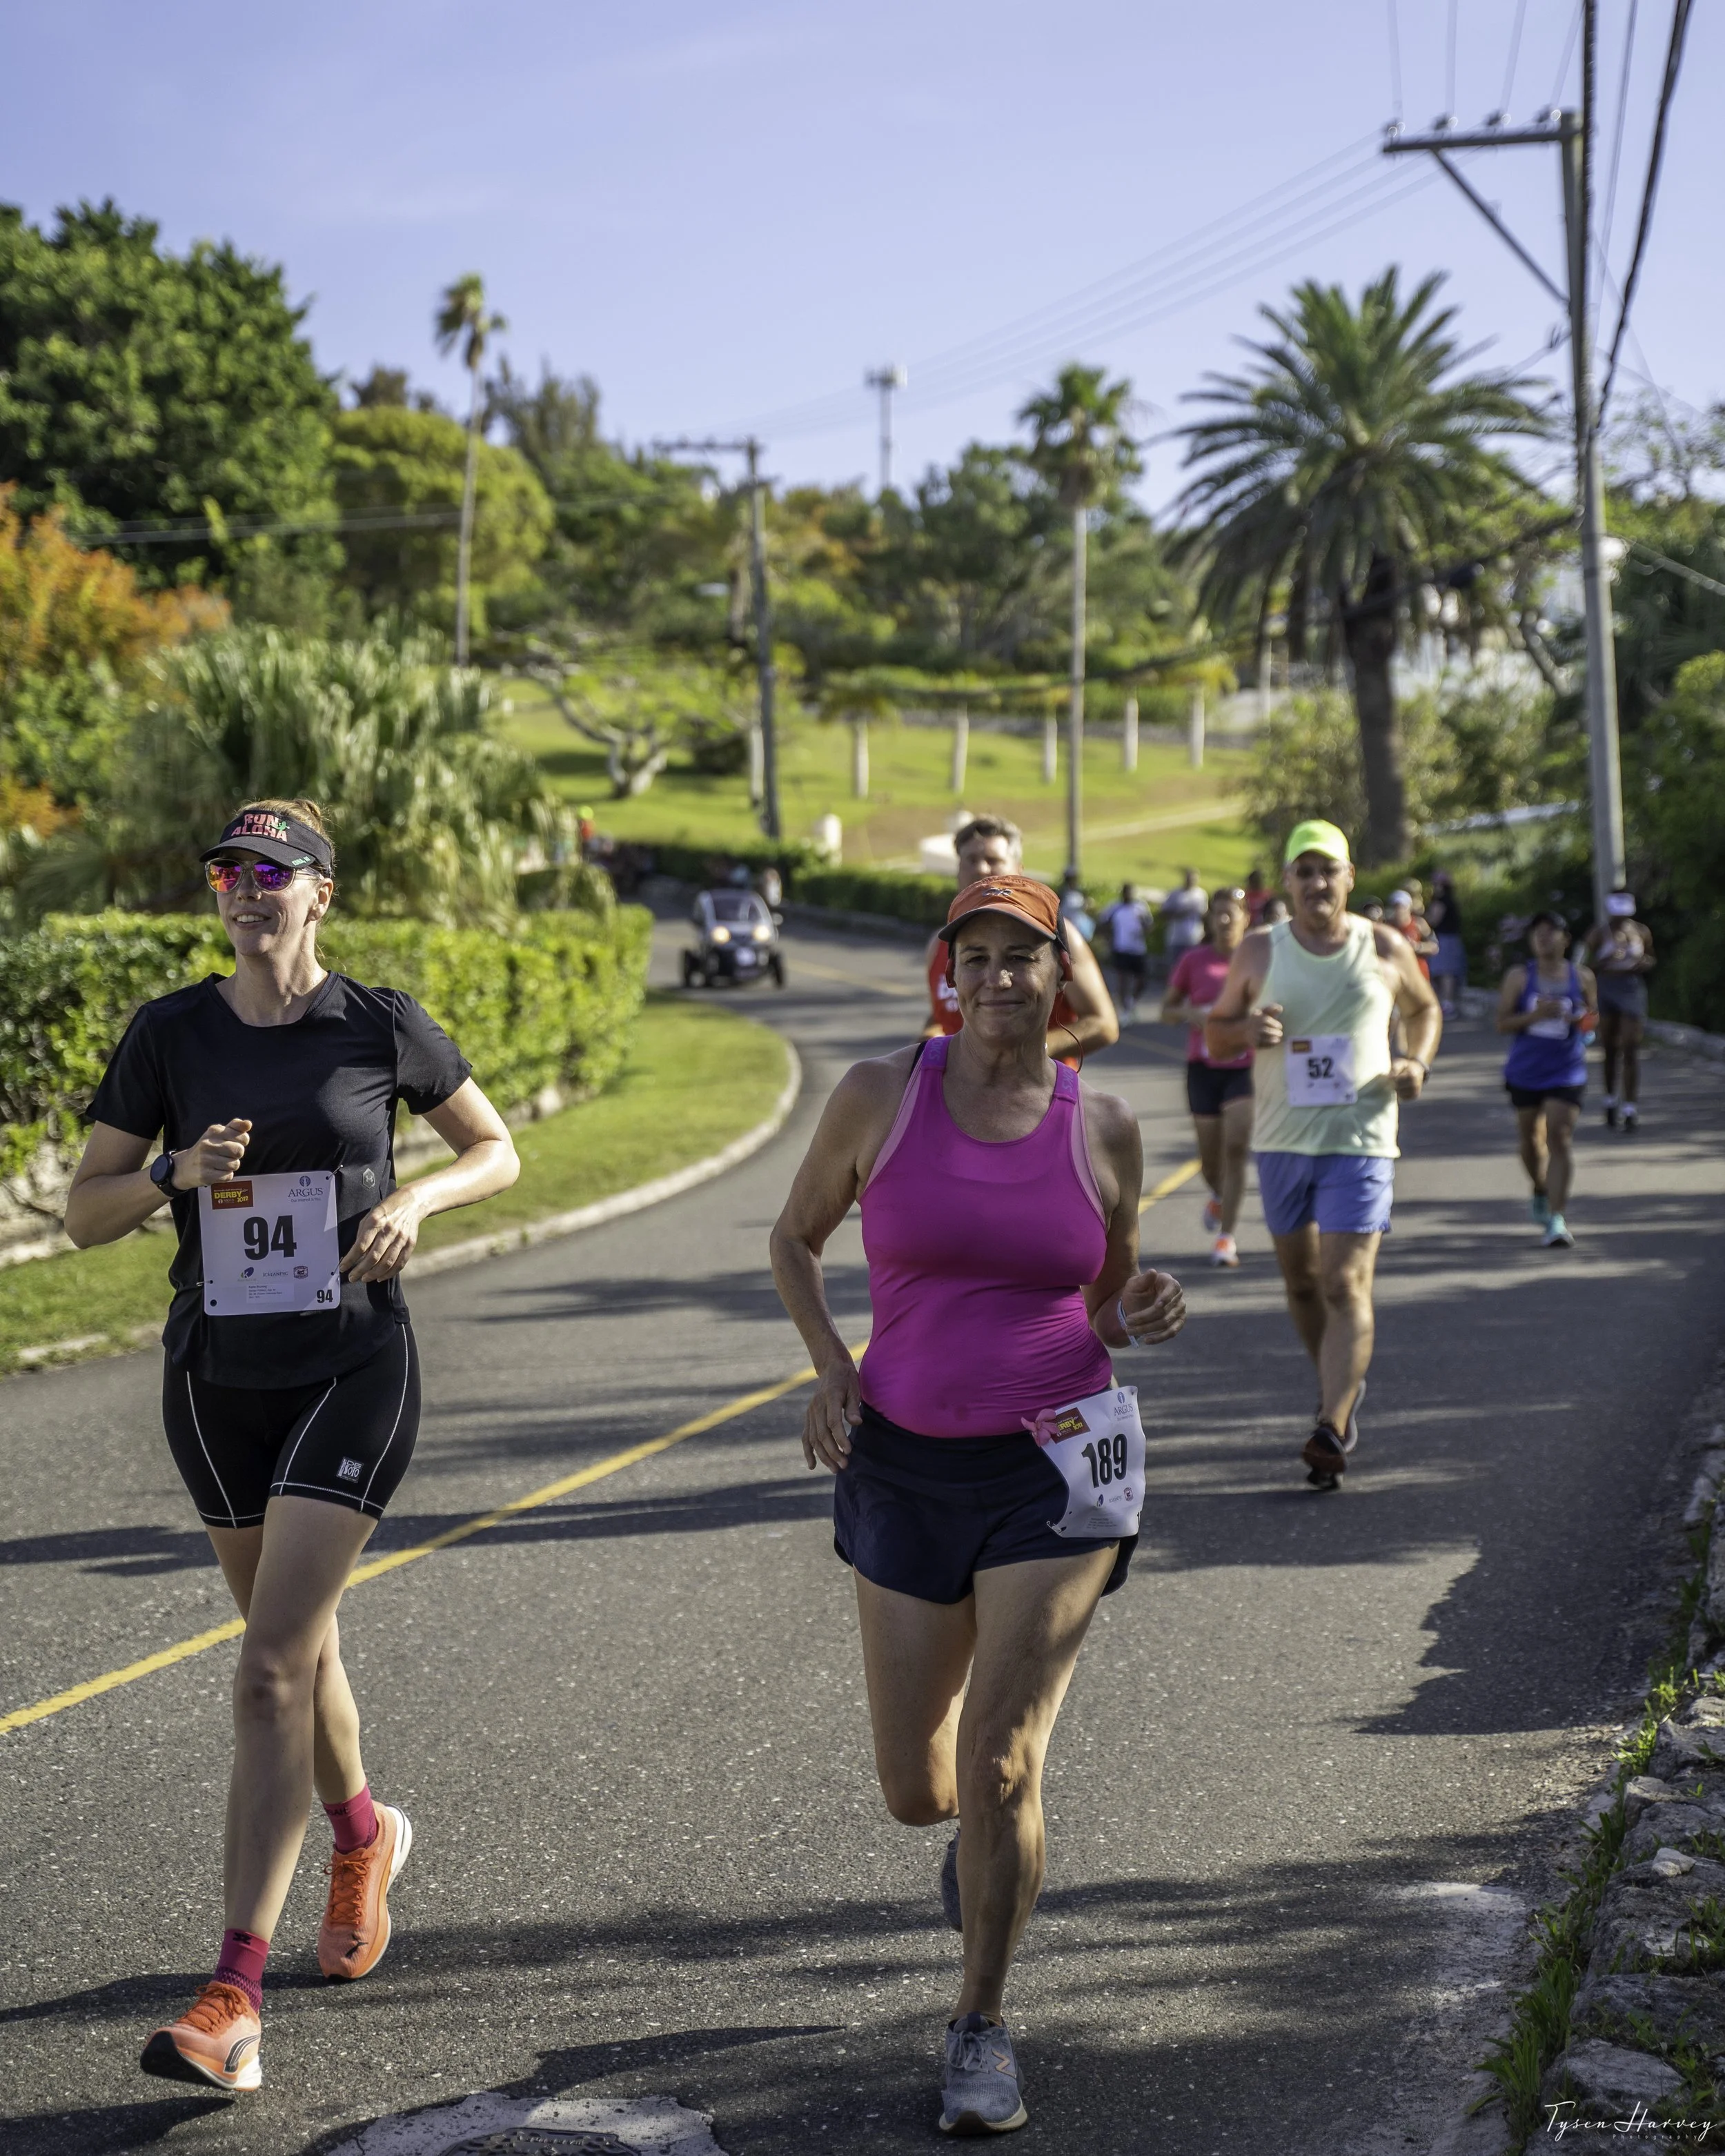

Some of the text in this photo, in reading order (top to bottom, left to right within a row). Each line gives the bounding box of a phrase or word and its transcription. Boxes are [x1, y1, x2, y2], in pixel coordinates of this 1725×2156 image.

[244, 813, 279, 827] RUN
[231, 824, 288, 842] ALOHA
[1307, 1056, 1334, 1079] 52
[214, 1190, 242, 1199] DERBY
[288, 1187, 324, 1198] ARGUS
[243, 1215, 297, 1260] 94
[316, 1289, 333, 1303] 94
[1114, 1403, 1134, 1416] ARGUS
[347, 1460, 362, 1470] DE
[1081, 1434, 1127, 1488] 189
